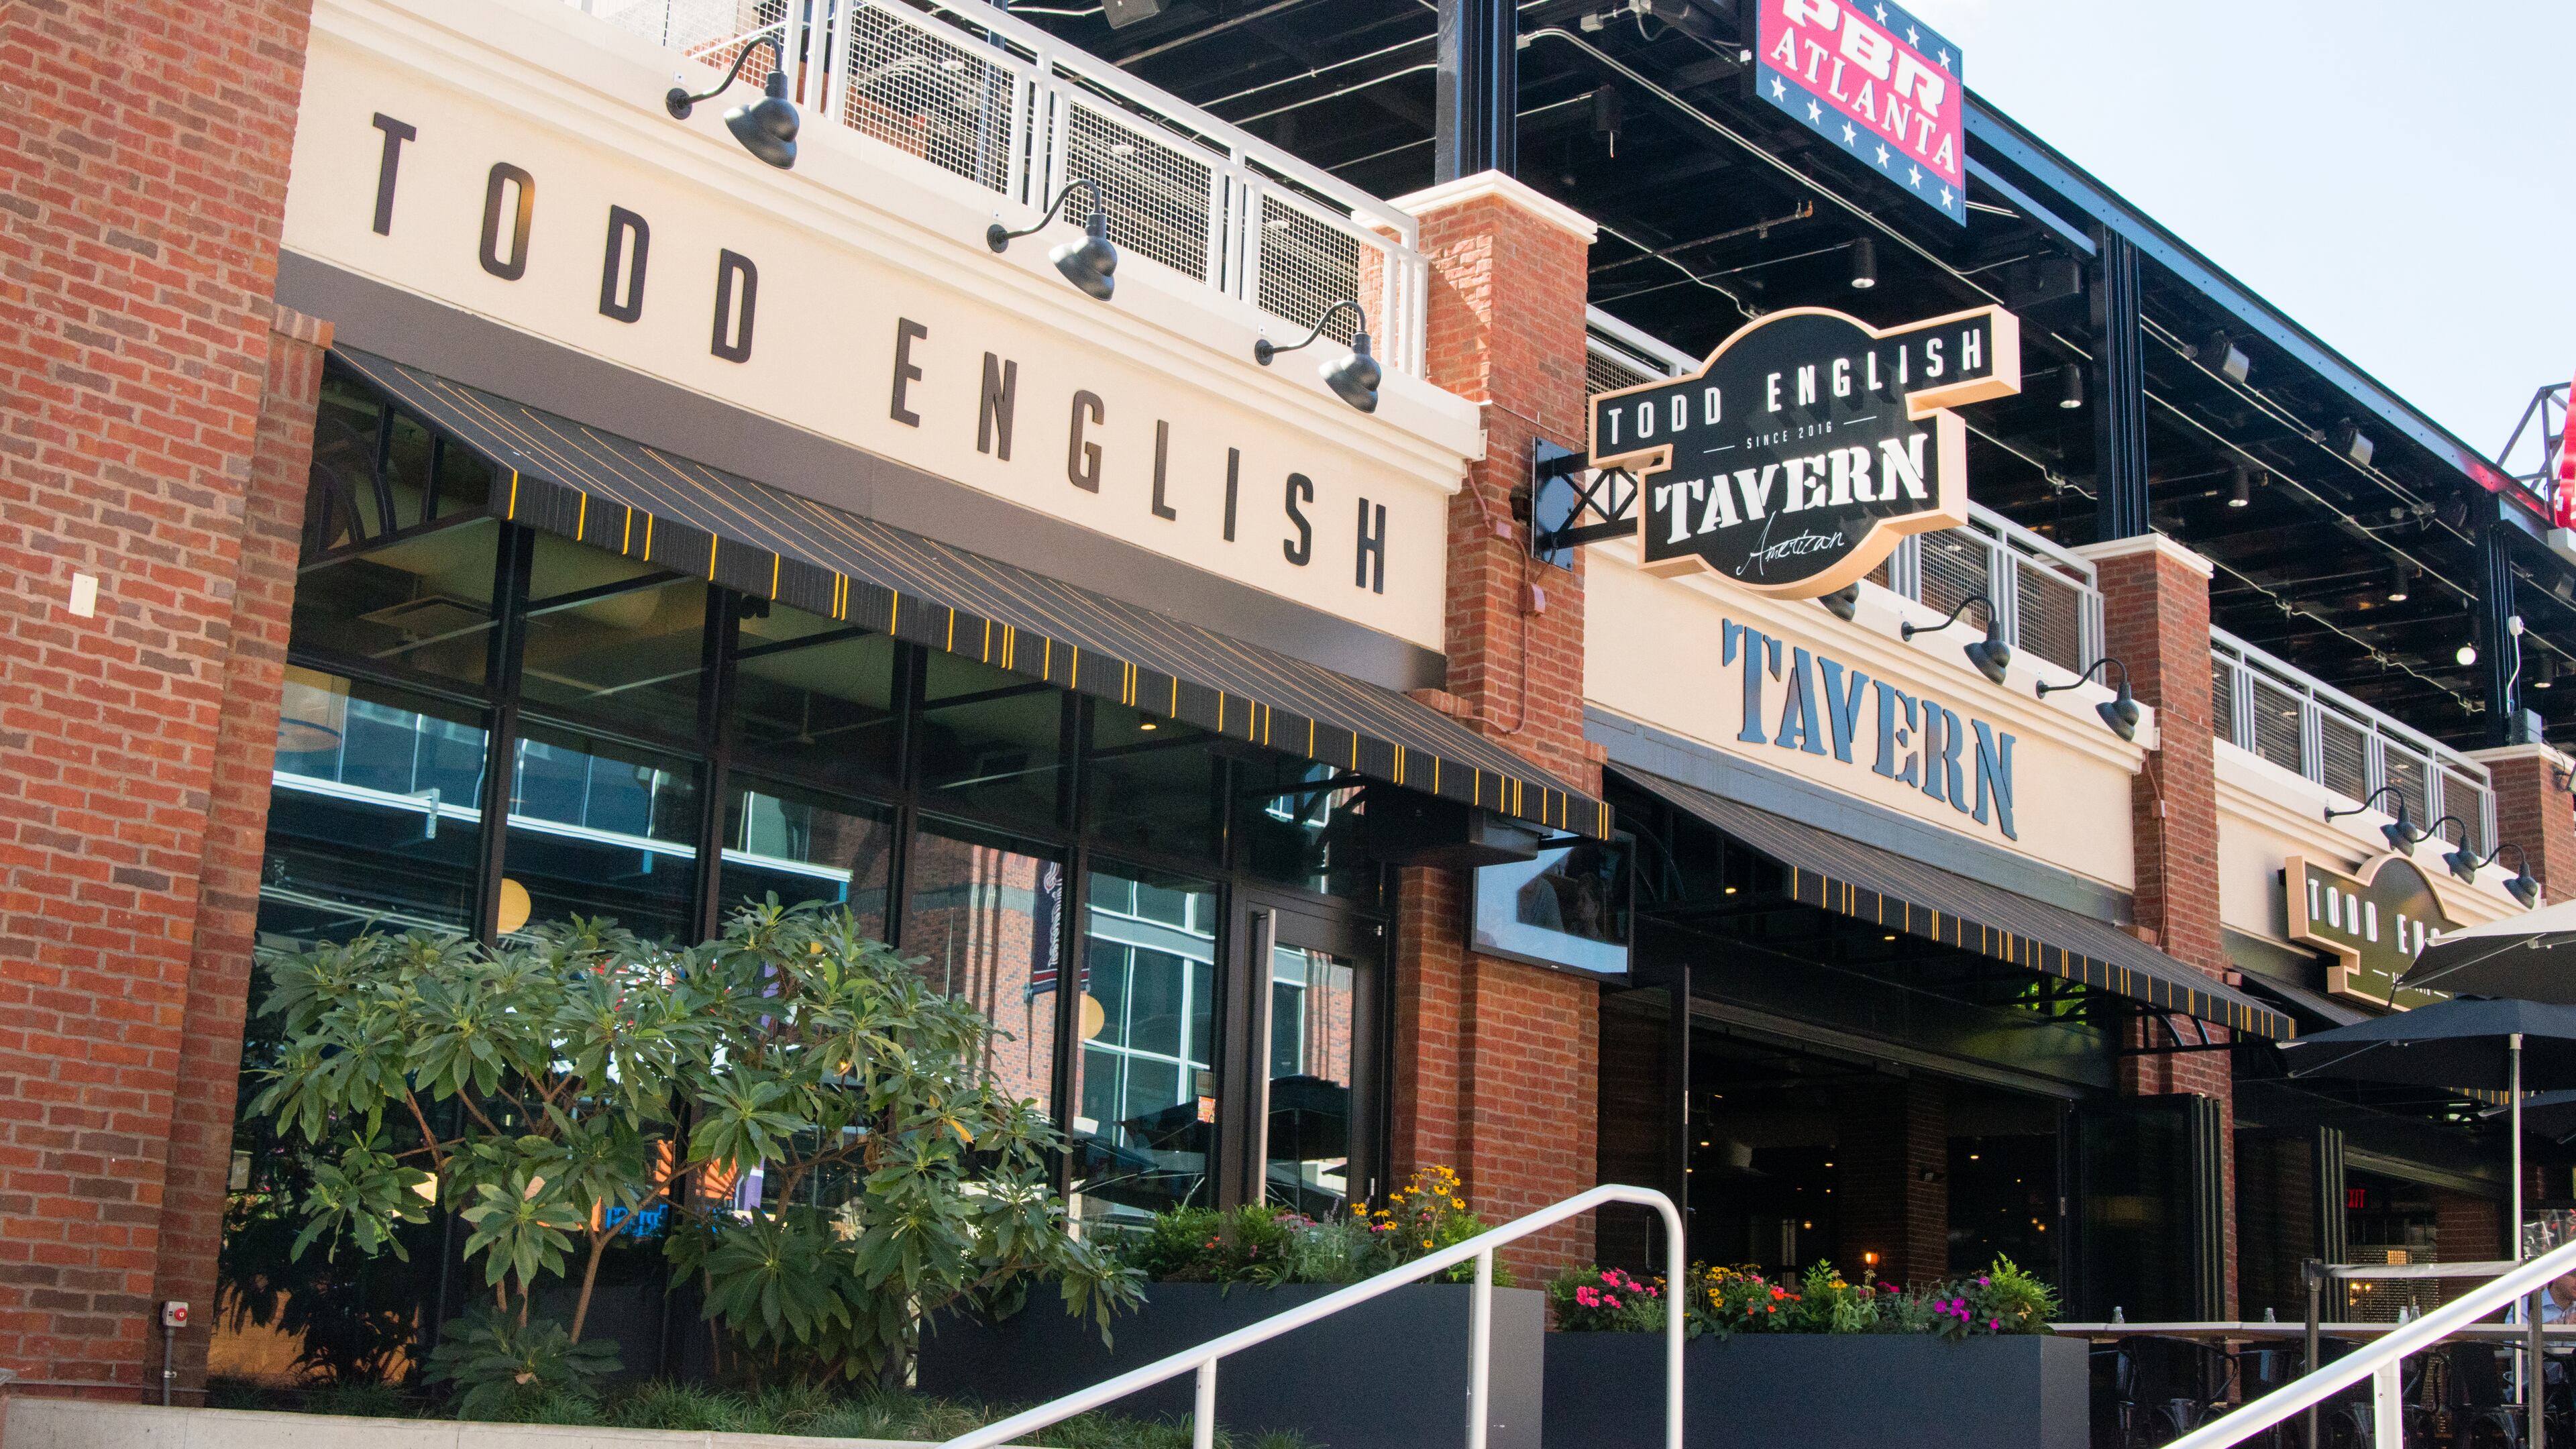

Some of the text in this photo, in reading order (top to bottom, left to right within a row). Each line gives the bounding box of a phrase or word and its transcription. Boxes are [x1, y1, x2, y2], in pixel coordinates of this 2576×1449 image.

[1770, 26, 1956, 174] ATLANTA
[1782, 0, 1946, 118] PBR
[373, 111, 1386, 594] TODD ENGLISH
[1608, 329, 1982, 444] TODD ENGLISH
[1654, 433, 1928, 545] TAVERN
[1746, 421, 1832, 449] SINCE 2016
[1735, 511, 1845, 576] American
[1722, 618, 2017, 841] TAVERN
[2308, 878, 2378, 943] TODD
[2346, 1188, 2366, 1208] XIT
